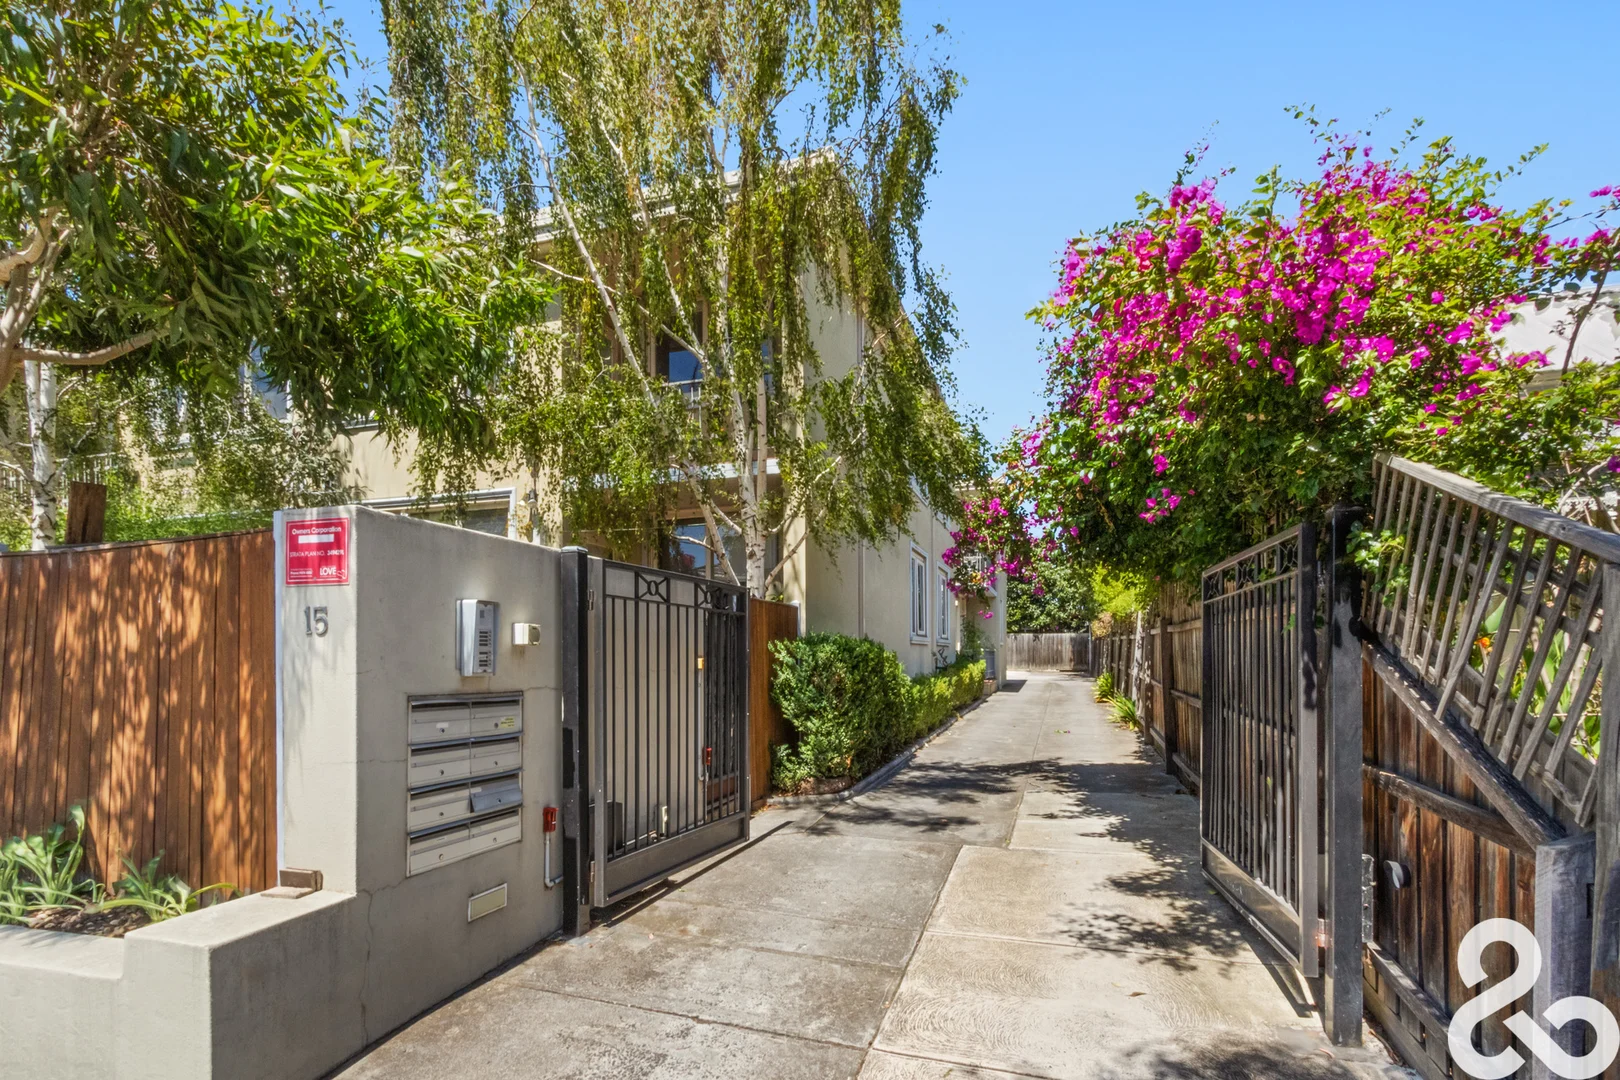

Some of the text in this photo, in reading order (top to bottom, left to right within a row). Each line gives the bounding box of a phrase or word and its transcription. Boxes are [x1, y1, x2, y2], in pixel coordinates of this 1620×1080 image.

[311, 526, 341, 534] Corporation
[320, 567, 336, 575] LOVE
[304, 606, 328, 637] 15
